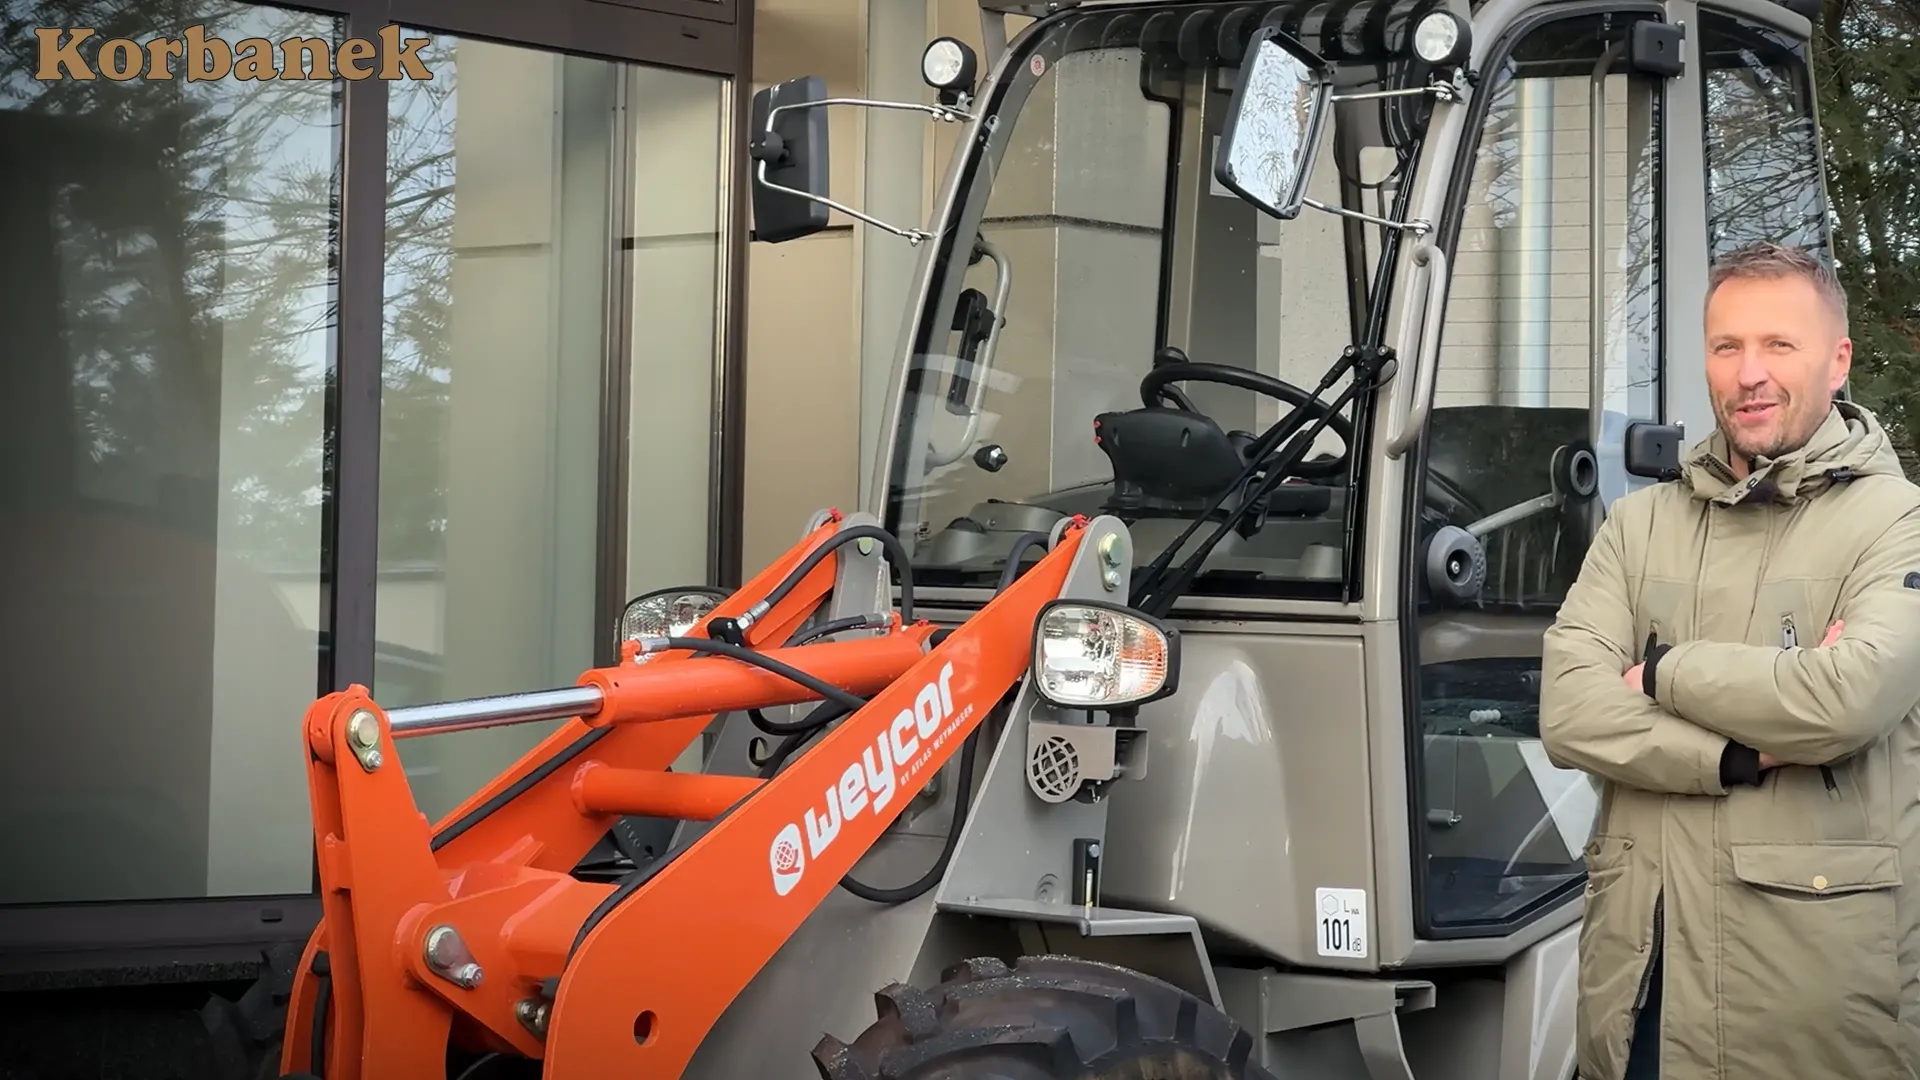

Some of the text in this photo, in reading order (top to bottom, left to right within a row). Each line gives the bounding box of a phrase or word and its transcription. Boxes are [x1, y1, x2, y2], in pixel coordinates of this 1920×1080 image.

[804, 661, 954, 860] weycor
[900, 703, 974, 786] BY ATLAS WEYHAUSEN
[1322, 917, 1350, 951] 101
